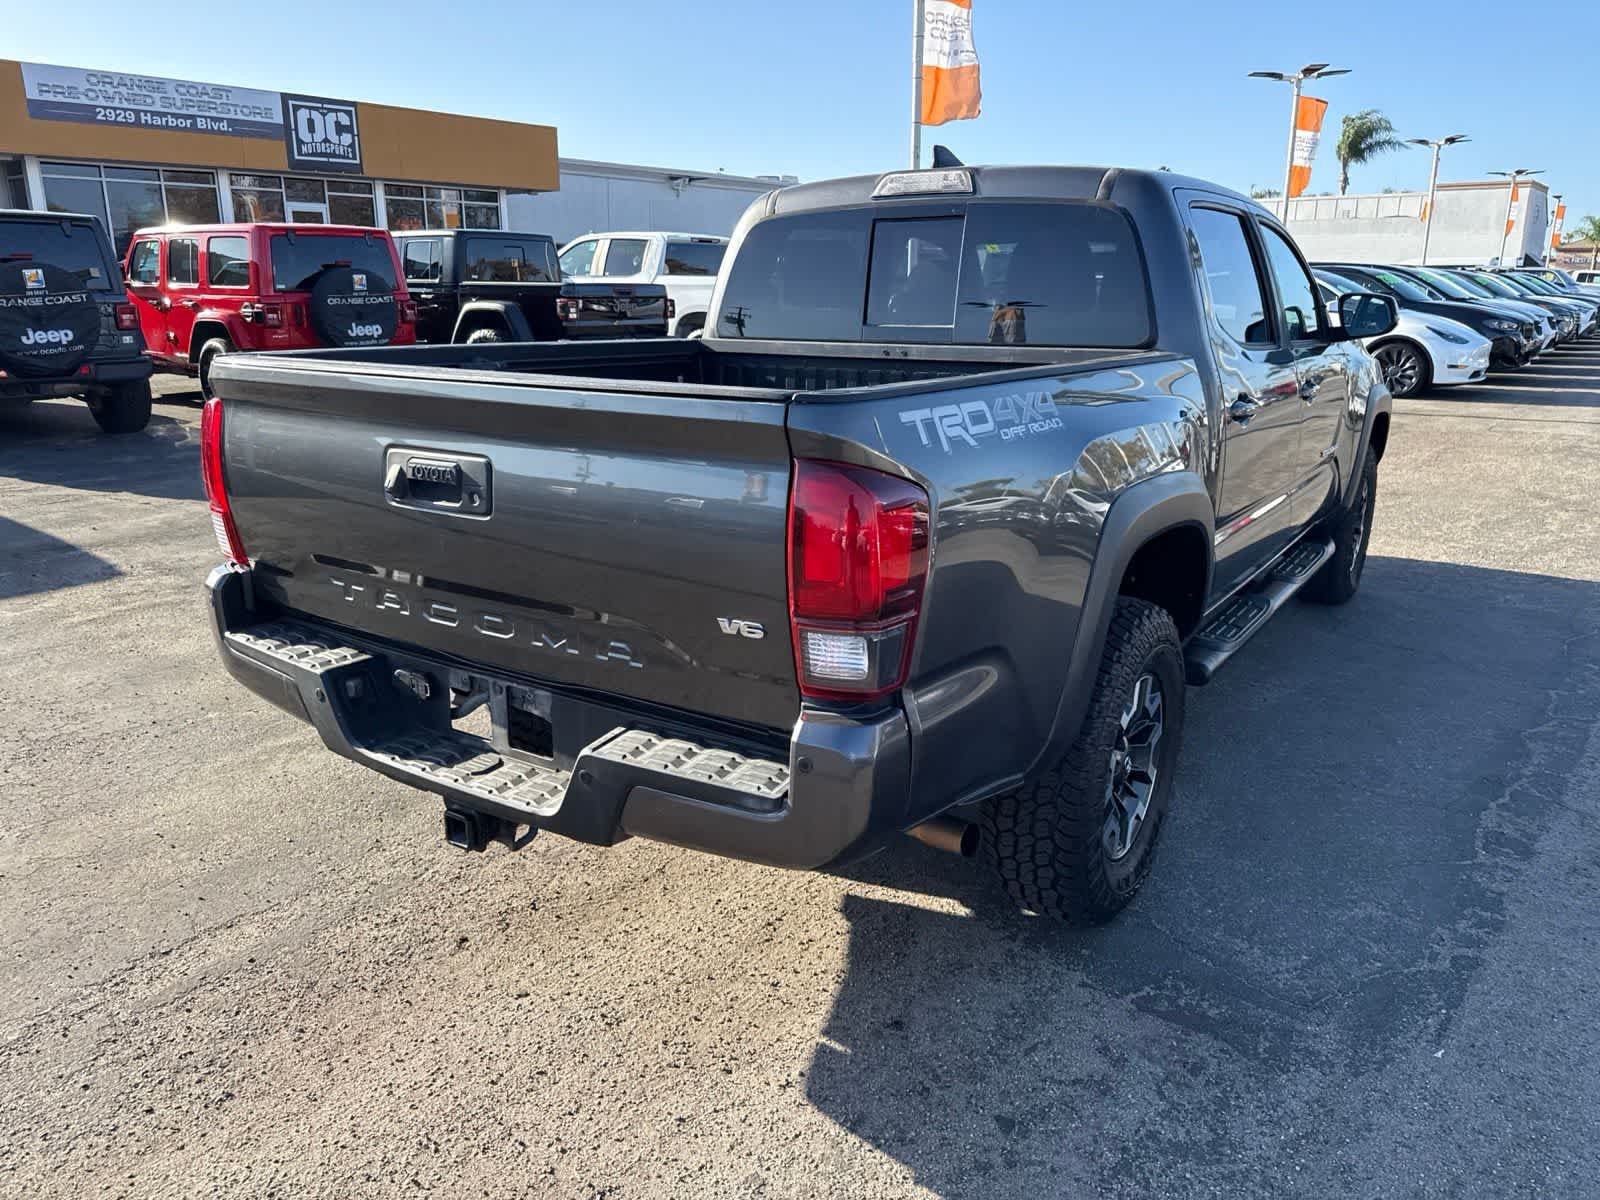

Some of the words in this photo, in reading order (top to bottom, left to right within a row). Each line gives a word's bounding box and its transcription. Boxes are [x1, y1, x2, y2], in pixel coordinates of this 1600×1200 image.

[86, 73, 168, 95] ORANGE
[175, 83, 233, 101] COAST
[37, 82, 155, 106] PRE-OWNED
[160, 96, 275, 119] SUPERSTORE
[95, 107, 136, 123] 2929
[140, 112, 193, 129] Harbor
[196, 117, 233, 132] Blvd.
[296, 107, 353, 146] OC
[301, 142, 353, 158] MOTORSPORTS
[0, 295, 43, 307] RANGE
[44, 293, 88, 305] COAST
[327, 296, 365, 306] ORANGE
[365, 295, 394, 304] COAST
[20, 327, 74, 345] Jeep
[347, 322, 383, 338] Jeep
[898, 400, 996, 454] TRD
[1000, 426, 1028, 440] OFF
[1029, 417, 1063, 434] ROAD
[408, 463, 454, 482] TOYOTA
[329, 576, 645, 669] TACOMA
[716, 617, 765, 639] V6
